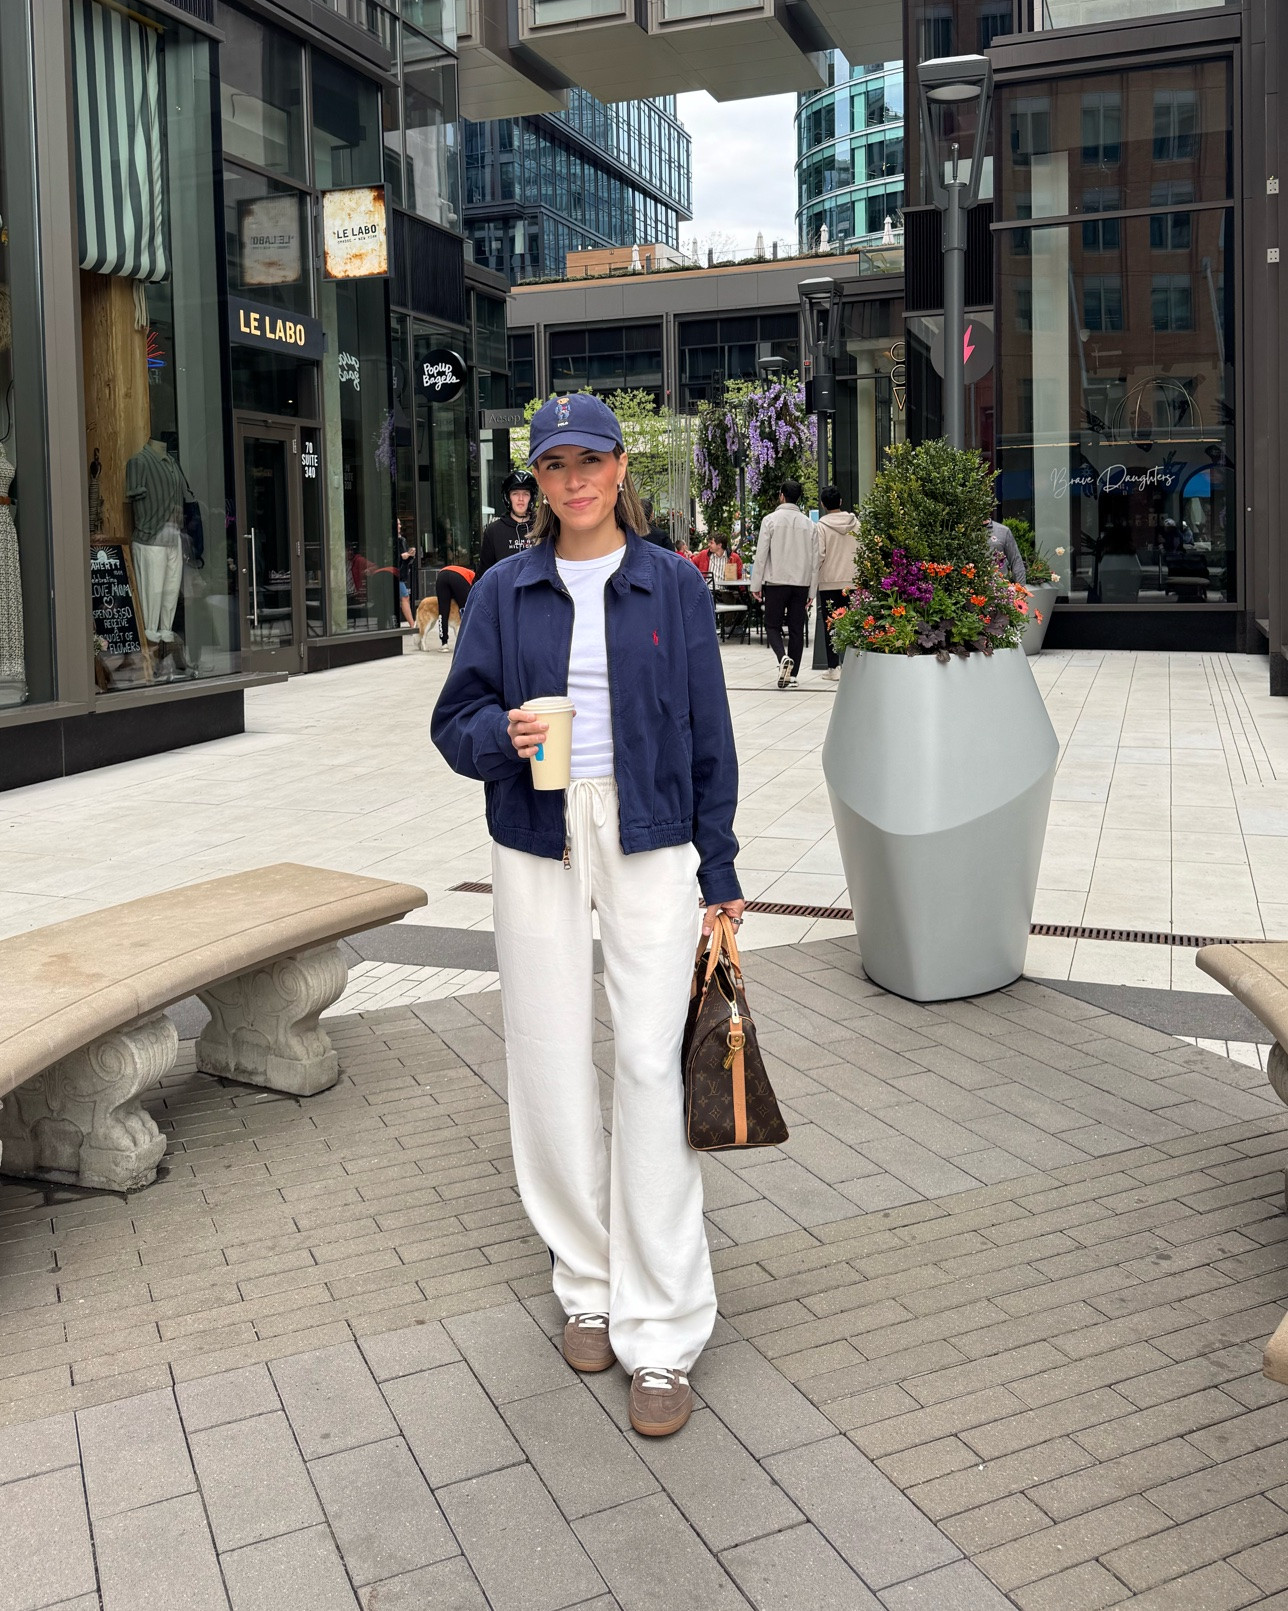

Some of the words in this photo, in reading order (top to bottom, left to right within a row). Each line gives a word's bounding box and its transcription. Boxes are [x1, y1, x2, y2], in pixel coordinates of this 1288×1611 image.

[240, 309, 261, 336] LE
[265, 316, 305, 346] LABO
[422, 372, 460, 391] Bagels
[488, 413, 520, 425] Aesop
[305, 441, 314, 454] 70
[301, 453, 318, 467] SUITE
[304, 466, 316, 479] 340
[1050, 466, 1094, 499] Brave
[1096, 464, 1176, 494] Daughters
[92, 608, 113, 619] SPEND
[103, 619, 129, 629] RECEIVE
[125, 631, 133, 641] OF
[109, 641, 141, 655] FLOWERS
